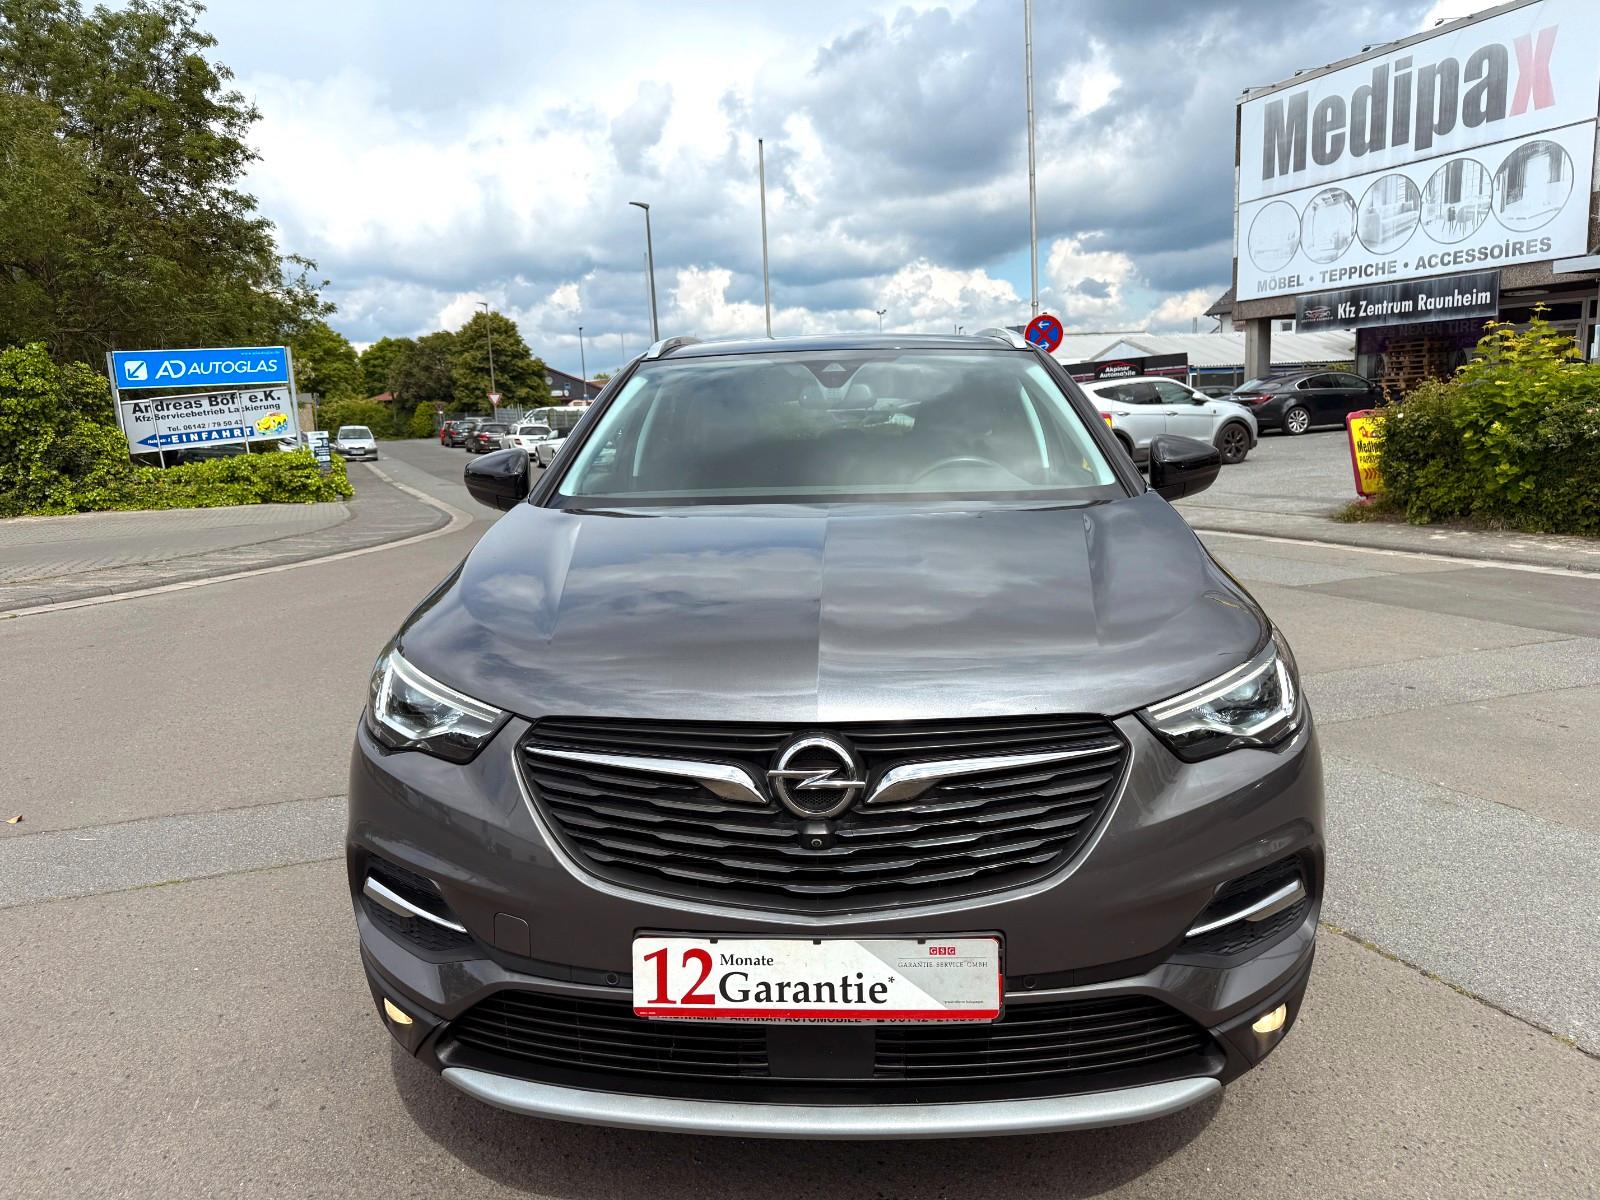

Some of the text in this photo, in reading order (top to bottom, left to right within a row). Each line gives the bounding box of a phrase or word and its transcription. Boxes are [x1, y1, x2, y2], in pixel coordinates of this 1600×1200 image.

[1262, 24, 1559, 181] Medipax
[1256, 273, 1304, 293] MÖBEL
[1320, 260, 1398, 284] TEPPICHE
[1337, 288, 1491, 319] Kfz Zentrum Raunheim
[1399, 322, 1443, 337] NEXEN
[1446, 320, 1479, 334] TIRE
[155, 359, 278, 379] AD AUTOGLAS
[132, 399, 203, 415] Andreas
[249, 389, 281, 403] e.K.
[135, 408, 226, 423] Kfz-Servicebetrieb
[171, 428, 252, 444] EINFAHRT
[183, 423, 206, 431] 06142
[929, 947, 956, 955] GSG
[966, 960, 988, 968] GMBH
[644, 948, 774, 1004] 12 Monate
